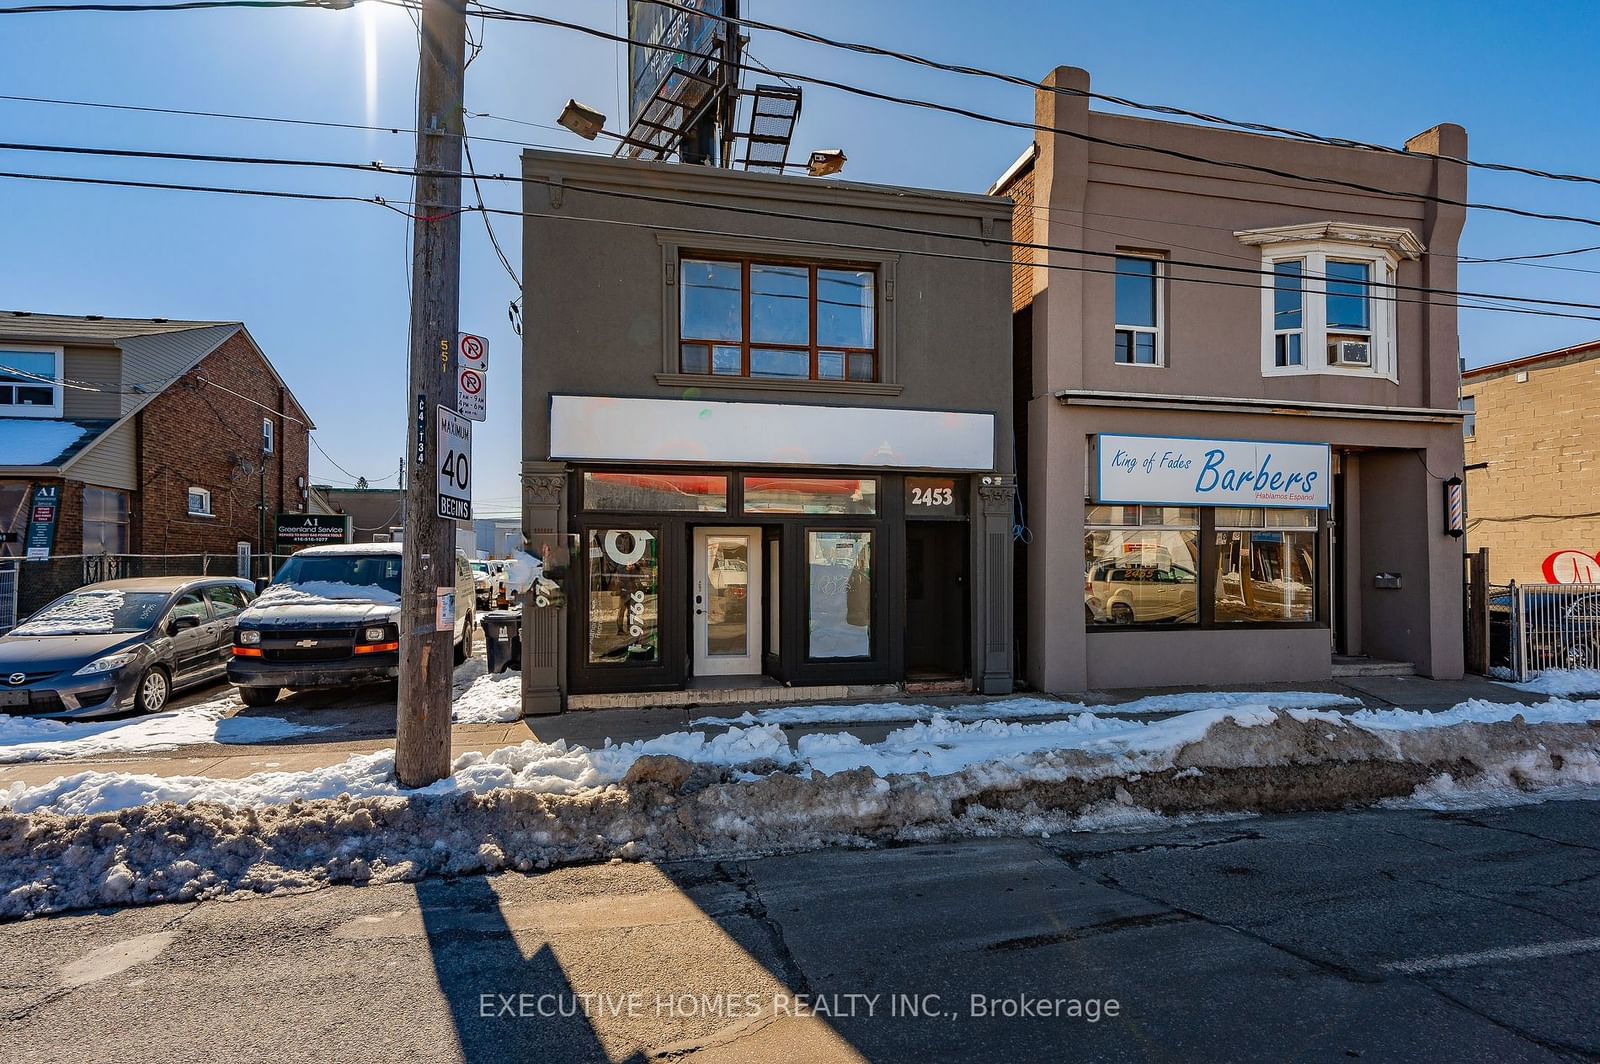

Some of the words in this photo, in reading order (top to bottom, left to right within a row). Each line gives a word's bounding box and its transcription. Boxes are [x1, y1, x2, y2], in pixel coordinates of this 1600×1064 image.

[441, 417, 469, 441] MAXIMUM
[441, 449, 469, 490] 40
[1111, 449, 1138, 473] King
[1142, 452, 1156, 474] of
[1159, 451, 1193, 469] Fades
[1195, 449, 1319, 493] Barbers
[37, 487, 55, 497] A1
[912, 487, 953, 506] 2453
[1256, 492, 1288, 500] Hablamos
[441, 497, 469, 518] BEGINS
[303, 518, 318, 526] A1
